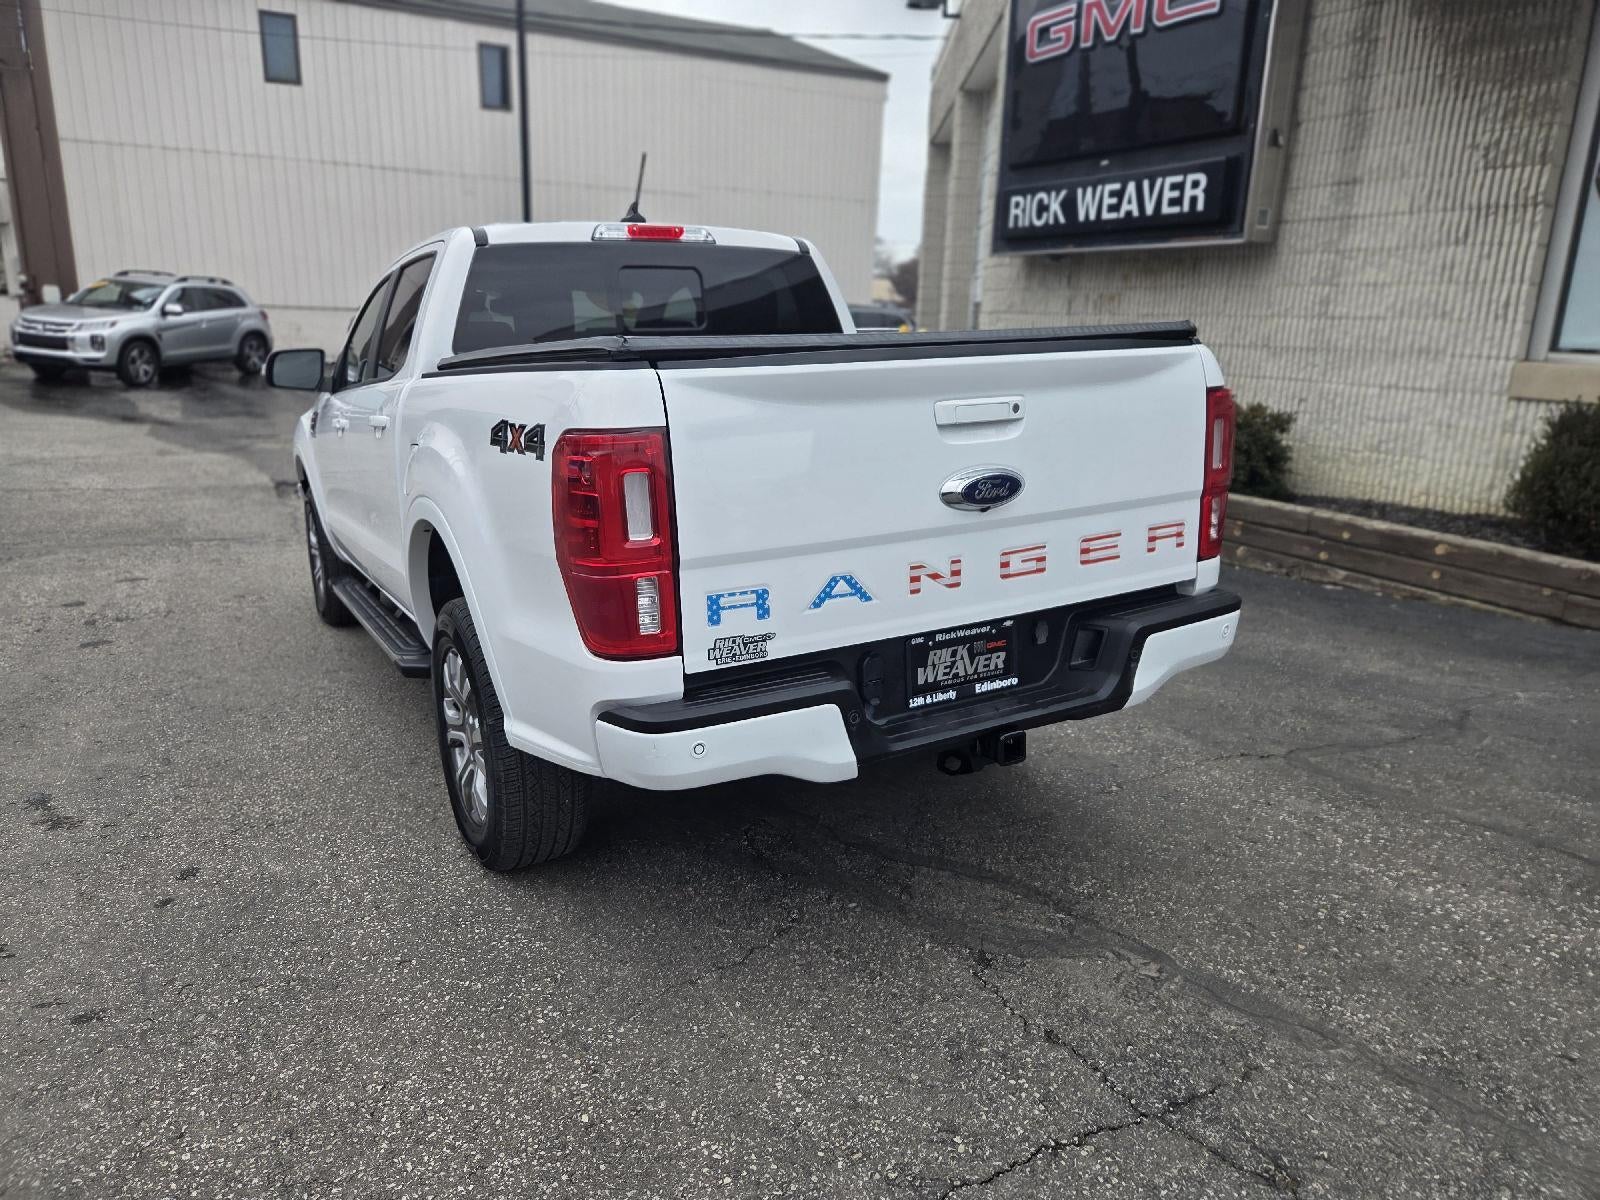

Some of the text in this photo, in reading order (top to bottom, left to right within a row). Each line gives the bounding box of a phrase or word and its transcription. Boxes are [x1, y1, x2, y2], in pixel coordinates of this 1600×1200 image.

[1008, 172, 1208, 228] RICK WEAVER
[974, 478, 1010, 500] Ford
[706, 521, 1186, 628] RANGER
[709, 641, 767, 660] WEAVER
[715, 636, 745, 649] RICK
[927, 639, 1007, 666] RICK GMC
[917, 651, 1007, 685] WEAVER
[975, 677, 1019, 693] Edinboro
[908, 697, 925, 708] 12th
[932, 689, 957, 702] Liberty
